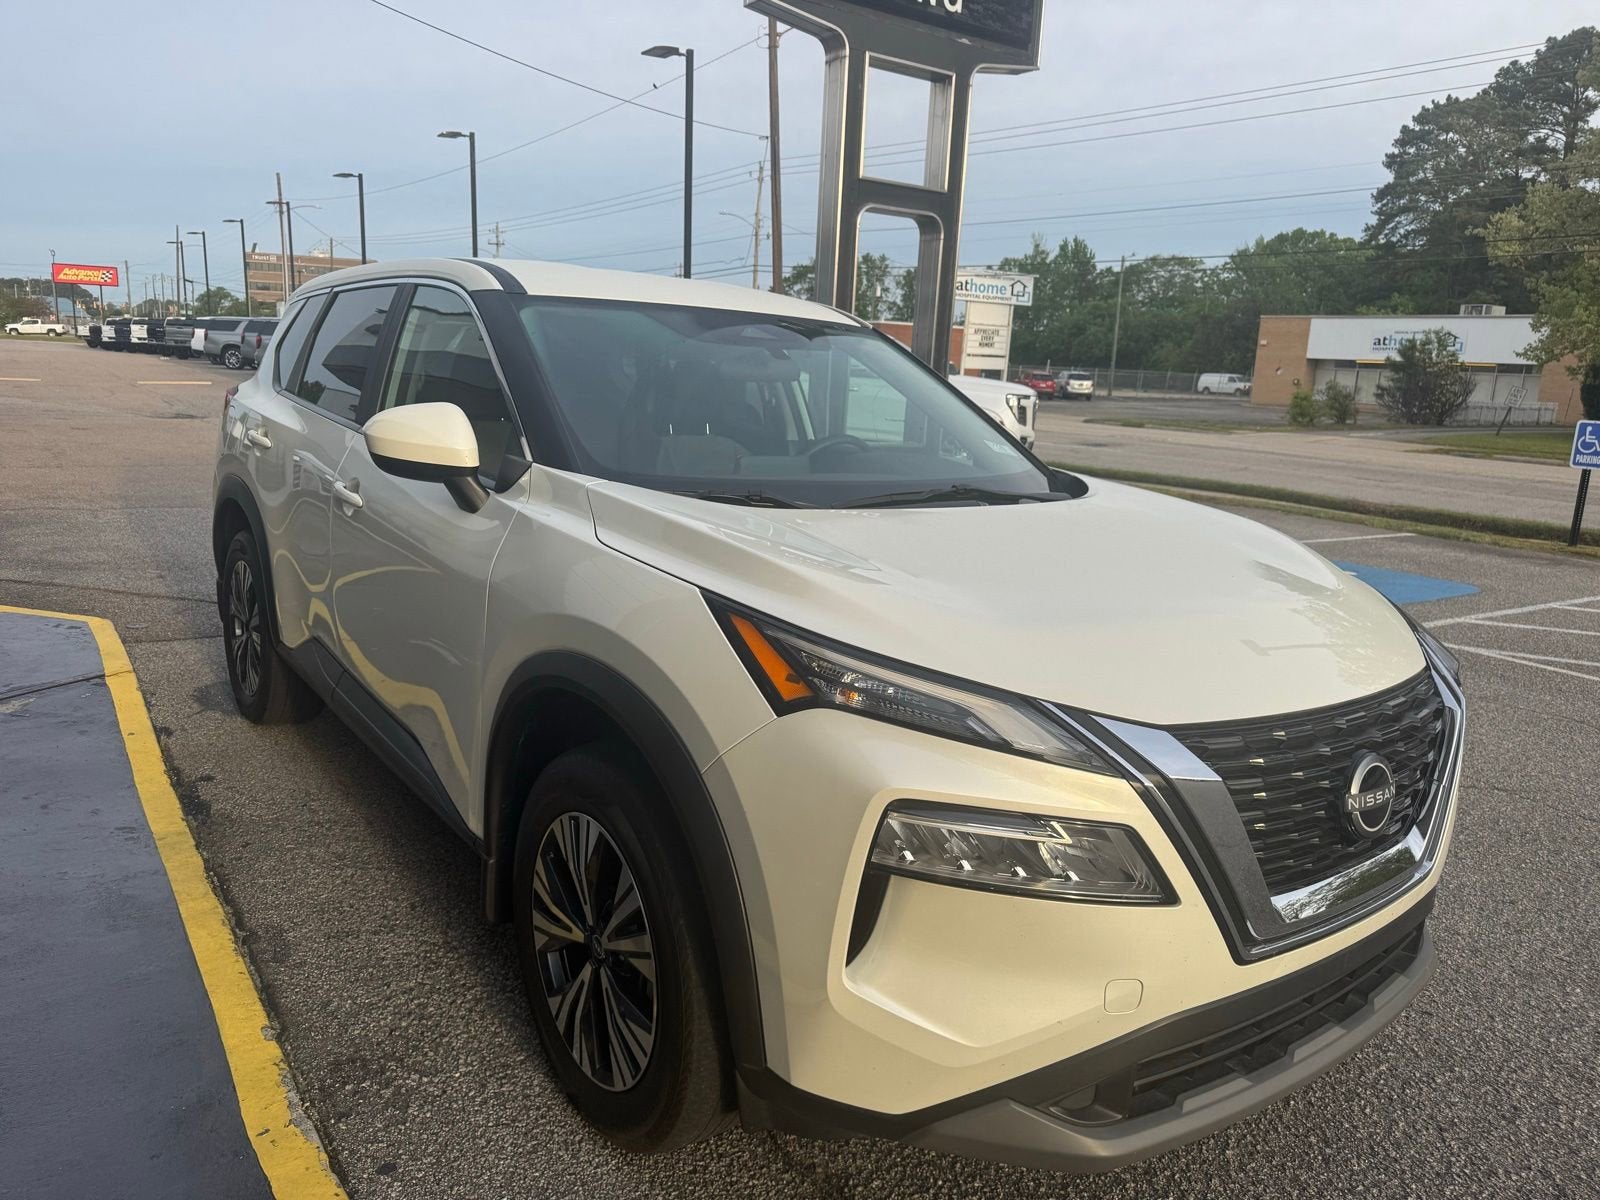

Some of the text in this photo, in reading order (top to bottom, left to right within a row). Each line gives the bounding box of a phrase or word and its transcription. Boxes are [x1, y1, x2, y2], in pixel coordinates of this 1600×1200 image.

[57, 273, 77, 281] Auto
[62, 267, 99, 277] Advance
[955, 278, 1007, 295] athome
[955, 292, 981, 300] HOSPITAL
[1575, 454, 1600, 465] PARKING
[1348, 783, 1396, 809] NISSAN
